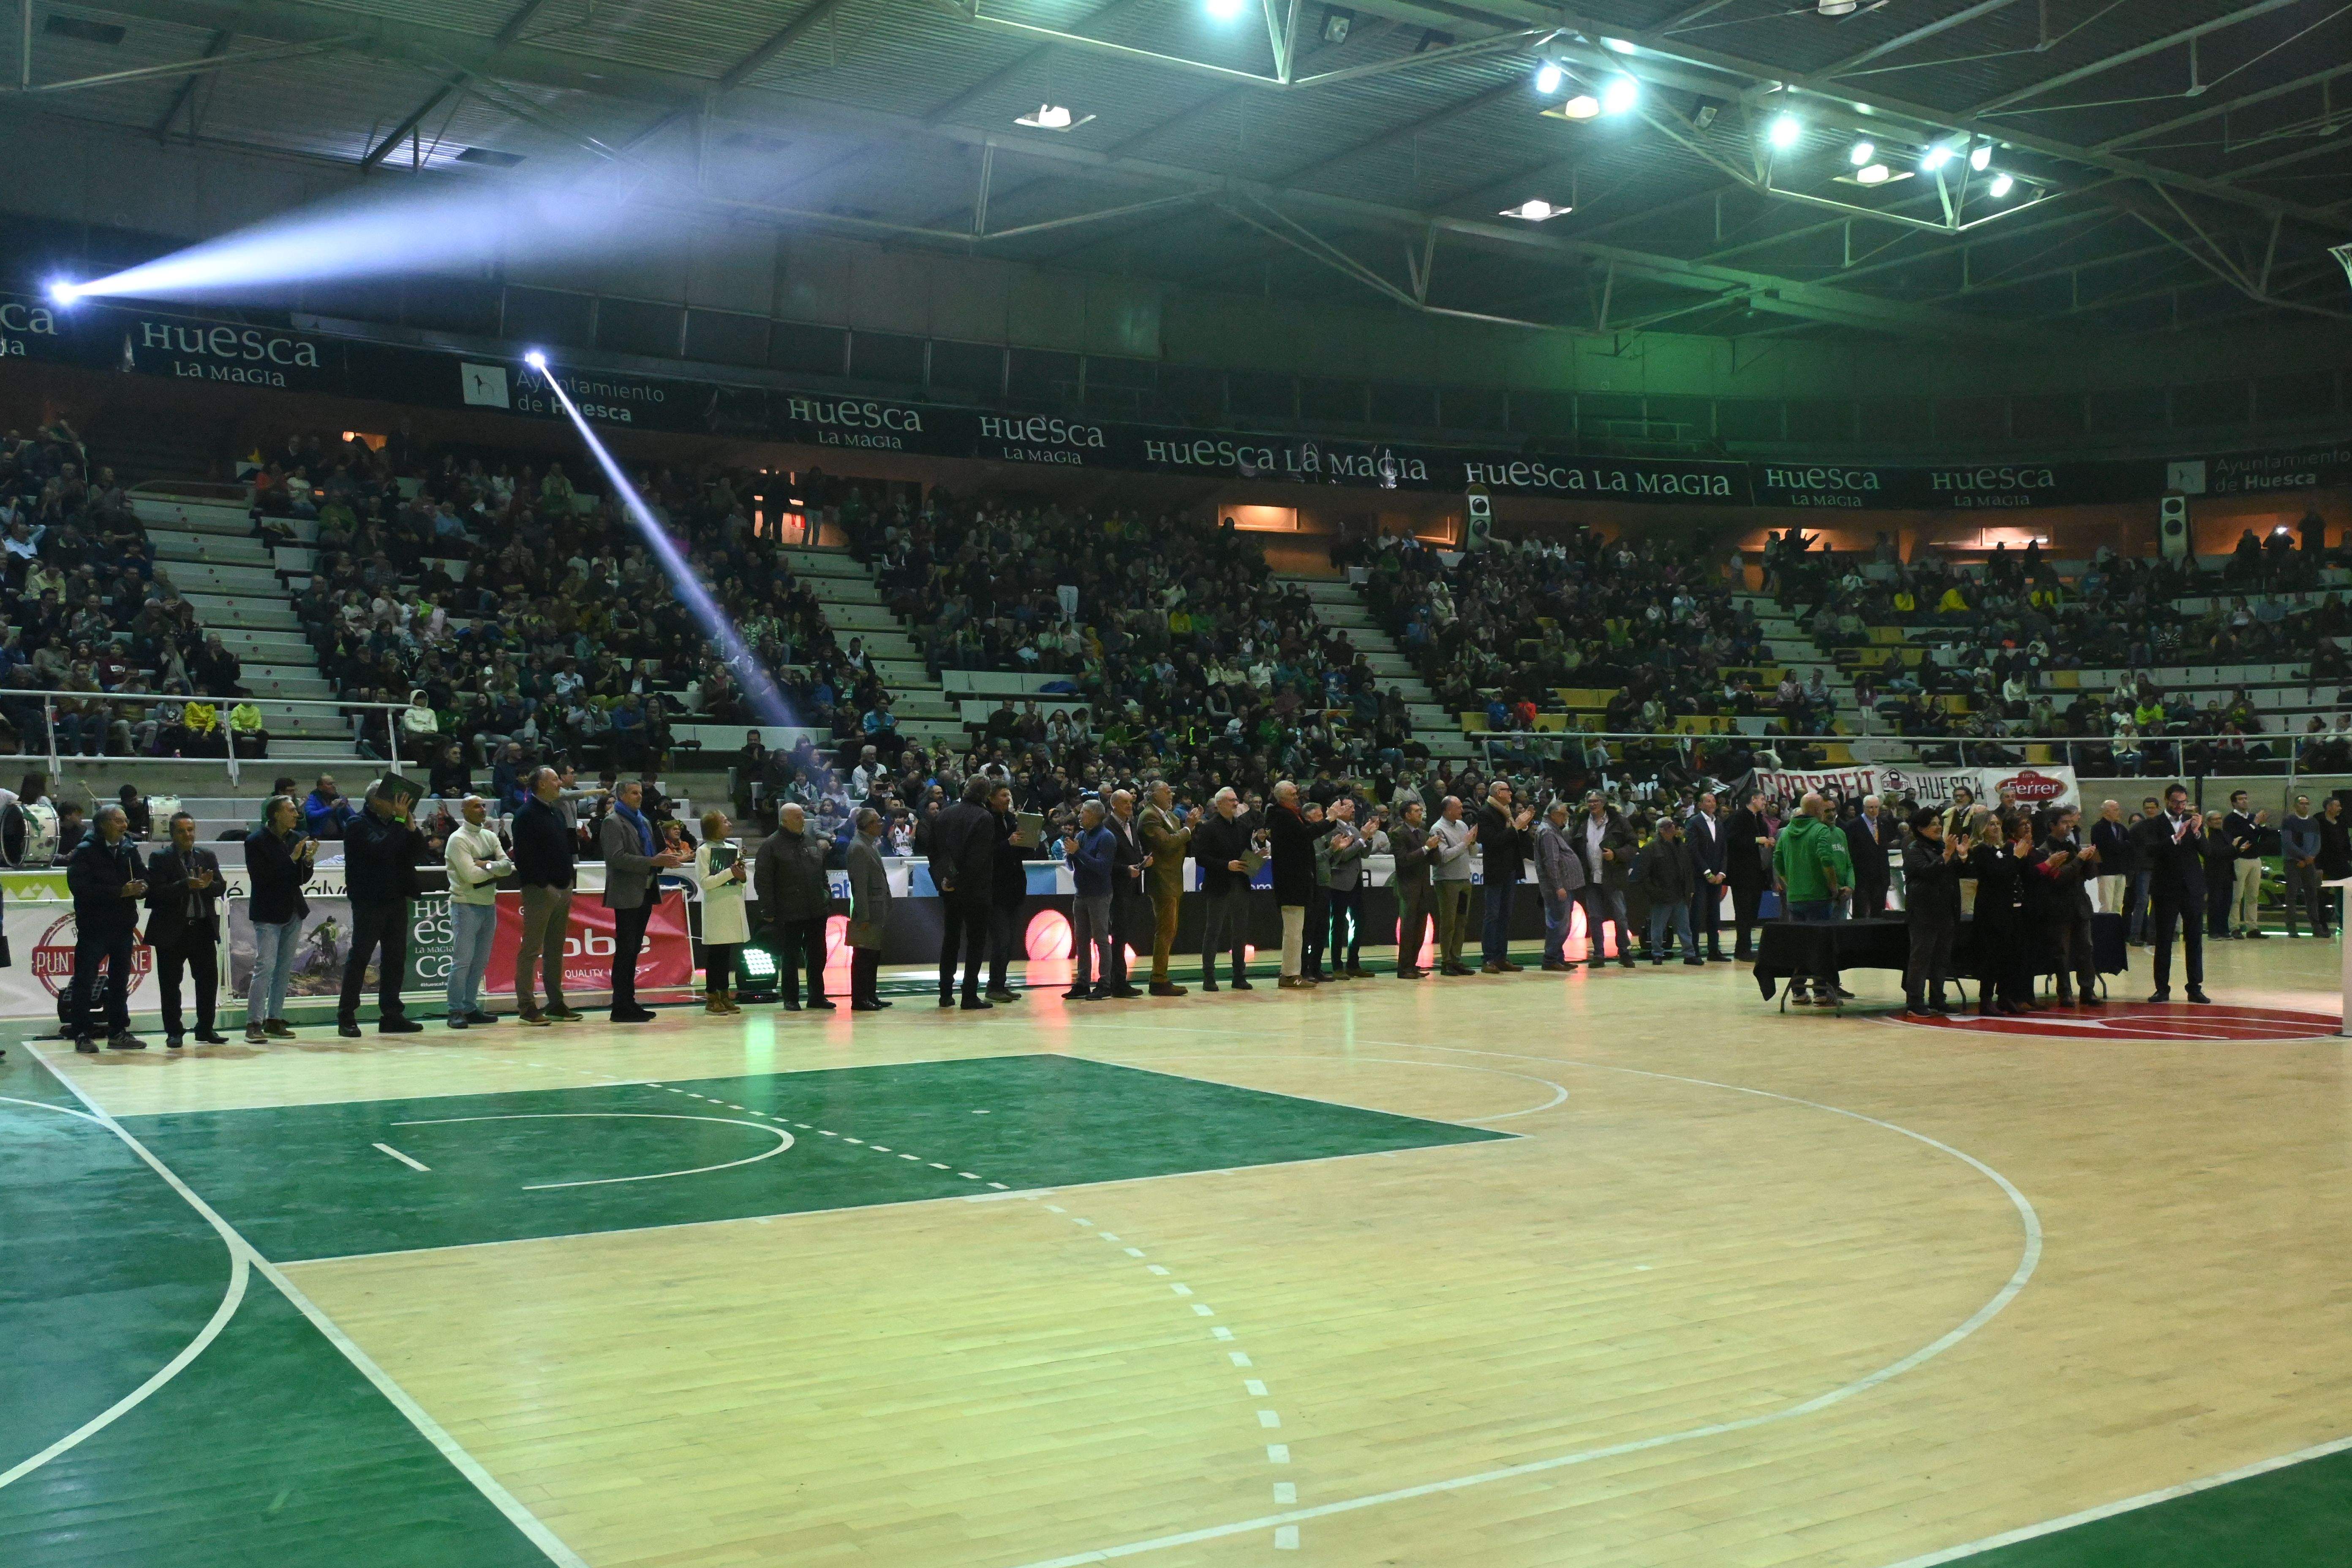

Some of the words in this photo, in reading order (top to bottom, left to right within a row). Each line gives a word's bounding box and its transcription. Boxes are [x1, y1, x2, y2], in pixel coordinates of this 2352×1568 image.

[142, 323, 320, 367] Huesca
[175, 361, 204, 378] La
[518, 395, 543, 412] de
[787, 397, 924, 432] Huesca
[818, 431, 840, 444] La
[979, 414, 1106, 447] Huesca
[1004, 446, 1023, 460] La
[1143, 439, 1274, 471] Huesca
[1284, 449, 1322, 472] La
[1464, 461, 1587, 490] Huesca
[1592, 471, 1629, 492] La
[1765, 468, 1881, 490] Huesca
[1930, 468, 2056, 490] Huesca
[2216, 477, 2238, 492] de
[2244, 472, 2317, 490] Huesca
[1791, 494, 1809, 506] La
[565, 969, 603, 978] QUALITY
